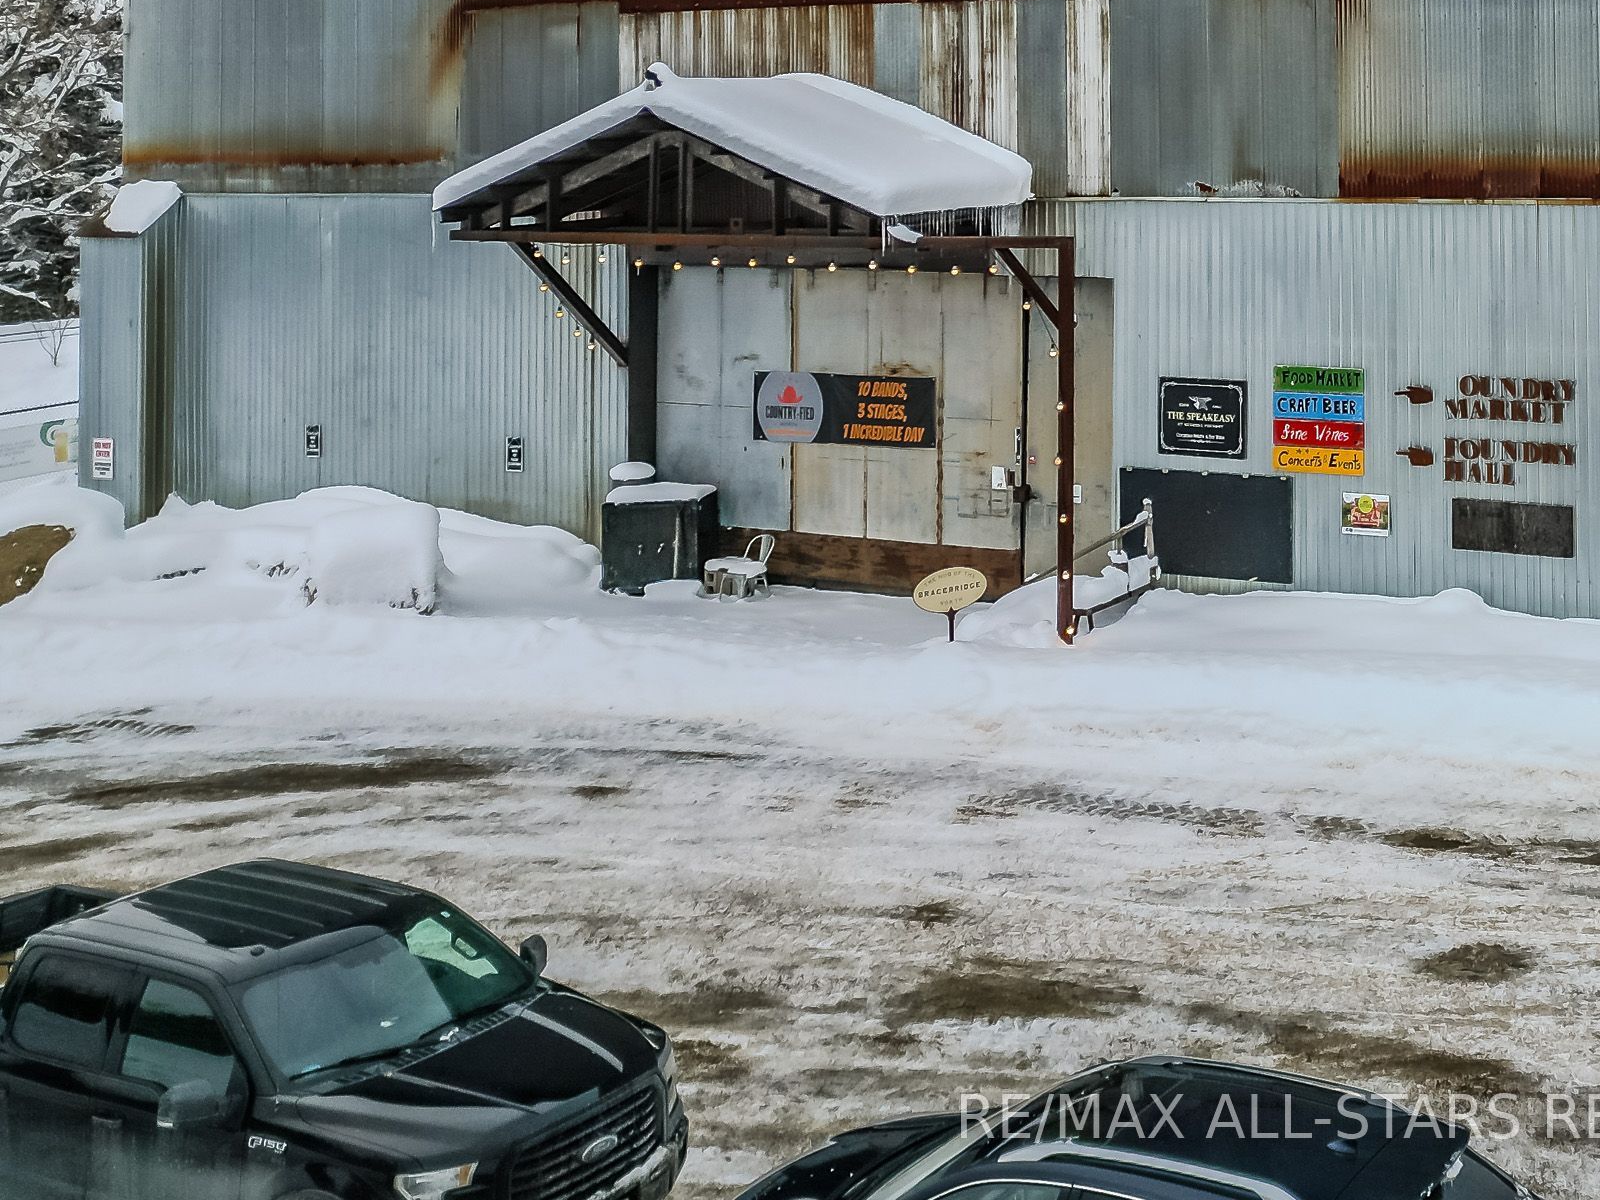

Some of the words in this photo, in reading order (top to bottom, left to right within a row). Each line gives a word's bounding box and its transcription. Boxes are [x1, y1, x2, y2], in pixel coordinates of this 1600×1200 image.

[1281, 371, 1313, 384] FOOD
[1315, 371, 1361, 387] MARKET
[858, 381, 871, 397] 10
[871, 381, 908, 401] BANDS,
[857, 402, 866, 419] 3
[867, 403, 908, 423] STAGES,
[1277, 397, 1318, 413] CRAFT
[1322, 397, 1356, 415] BEER
[1444, 399, 1567, 425] MARKET
[1167, 411, 1185, 420] THE
[1186, 413, 1235, 423] SPEAKEASY
[843, 423, 850, 439] 1
[849, 424, 904, 441] INCREDIBLE
[903, 426, 925, 443] DAY
[1328, 453, 1361, 470] Events
[1444, 437, 1577, 466] FOUNDRY
[1444, 460, 1517, 486] HALL
[917, 581, 981, 598] BRACEBRIDGE
